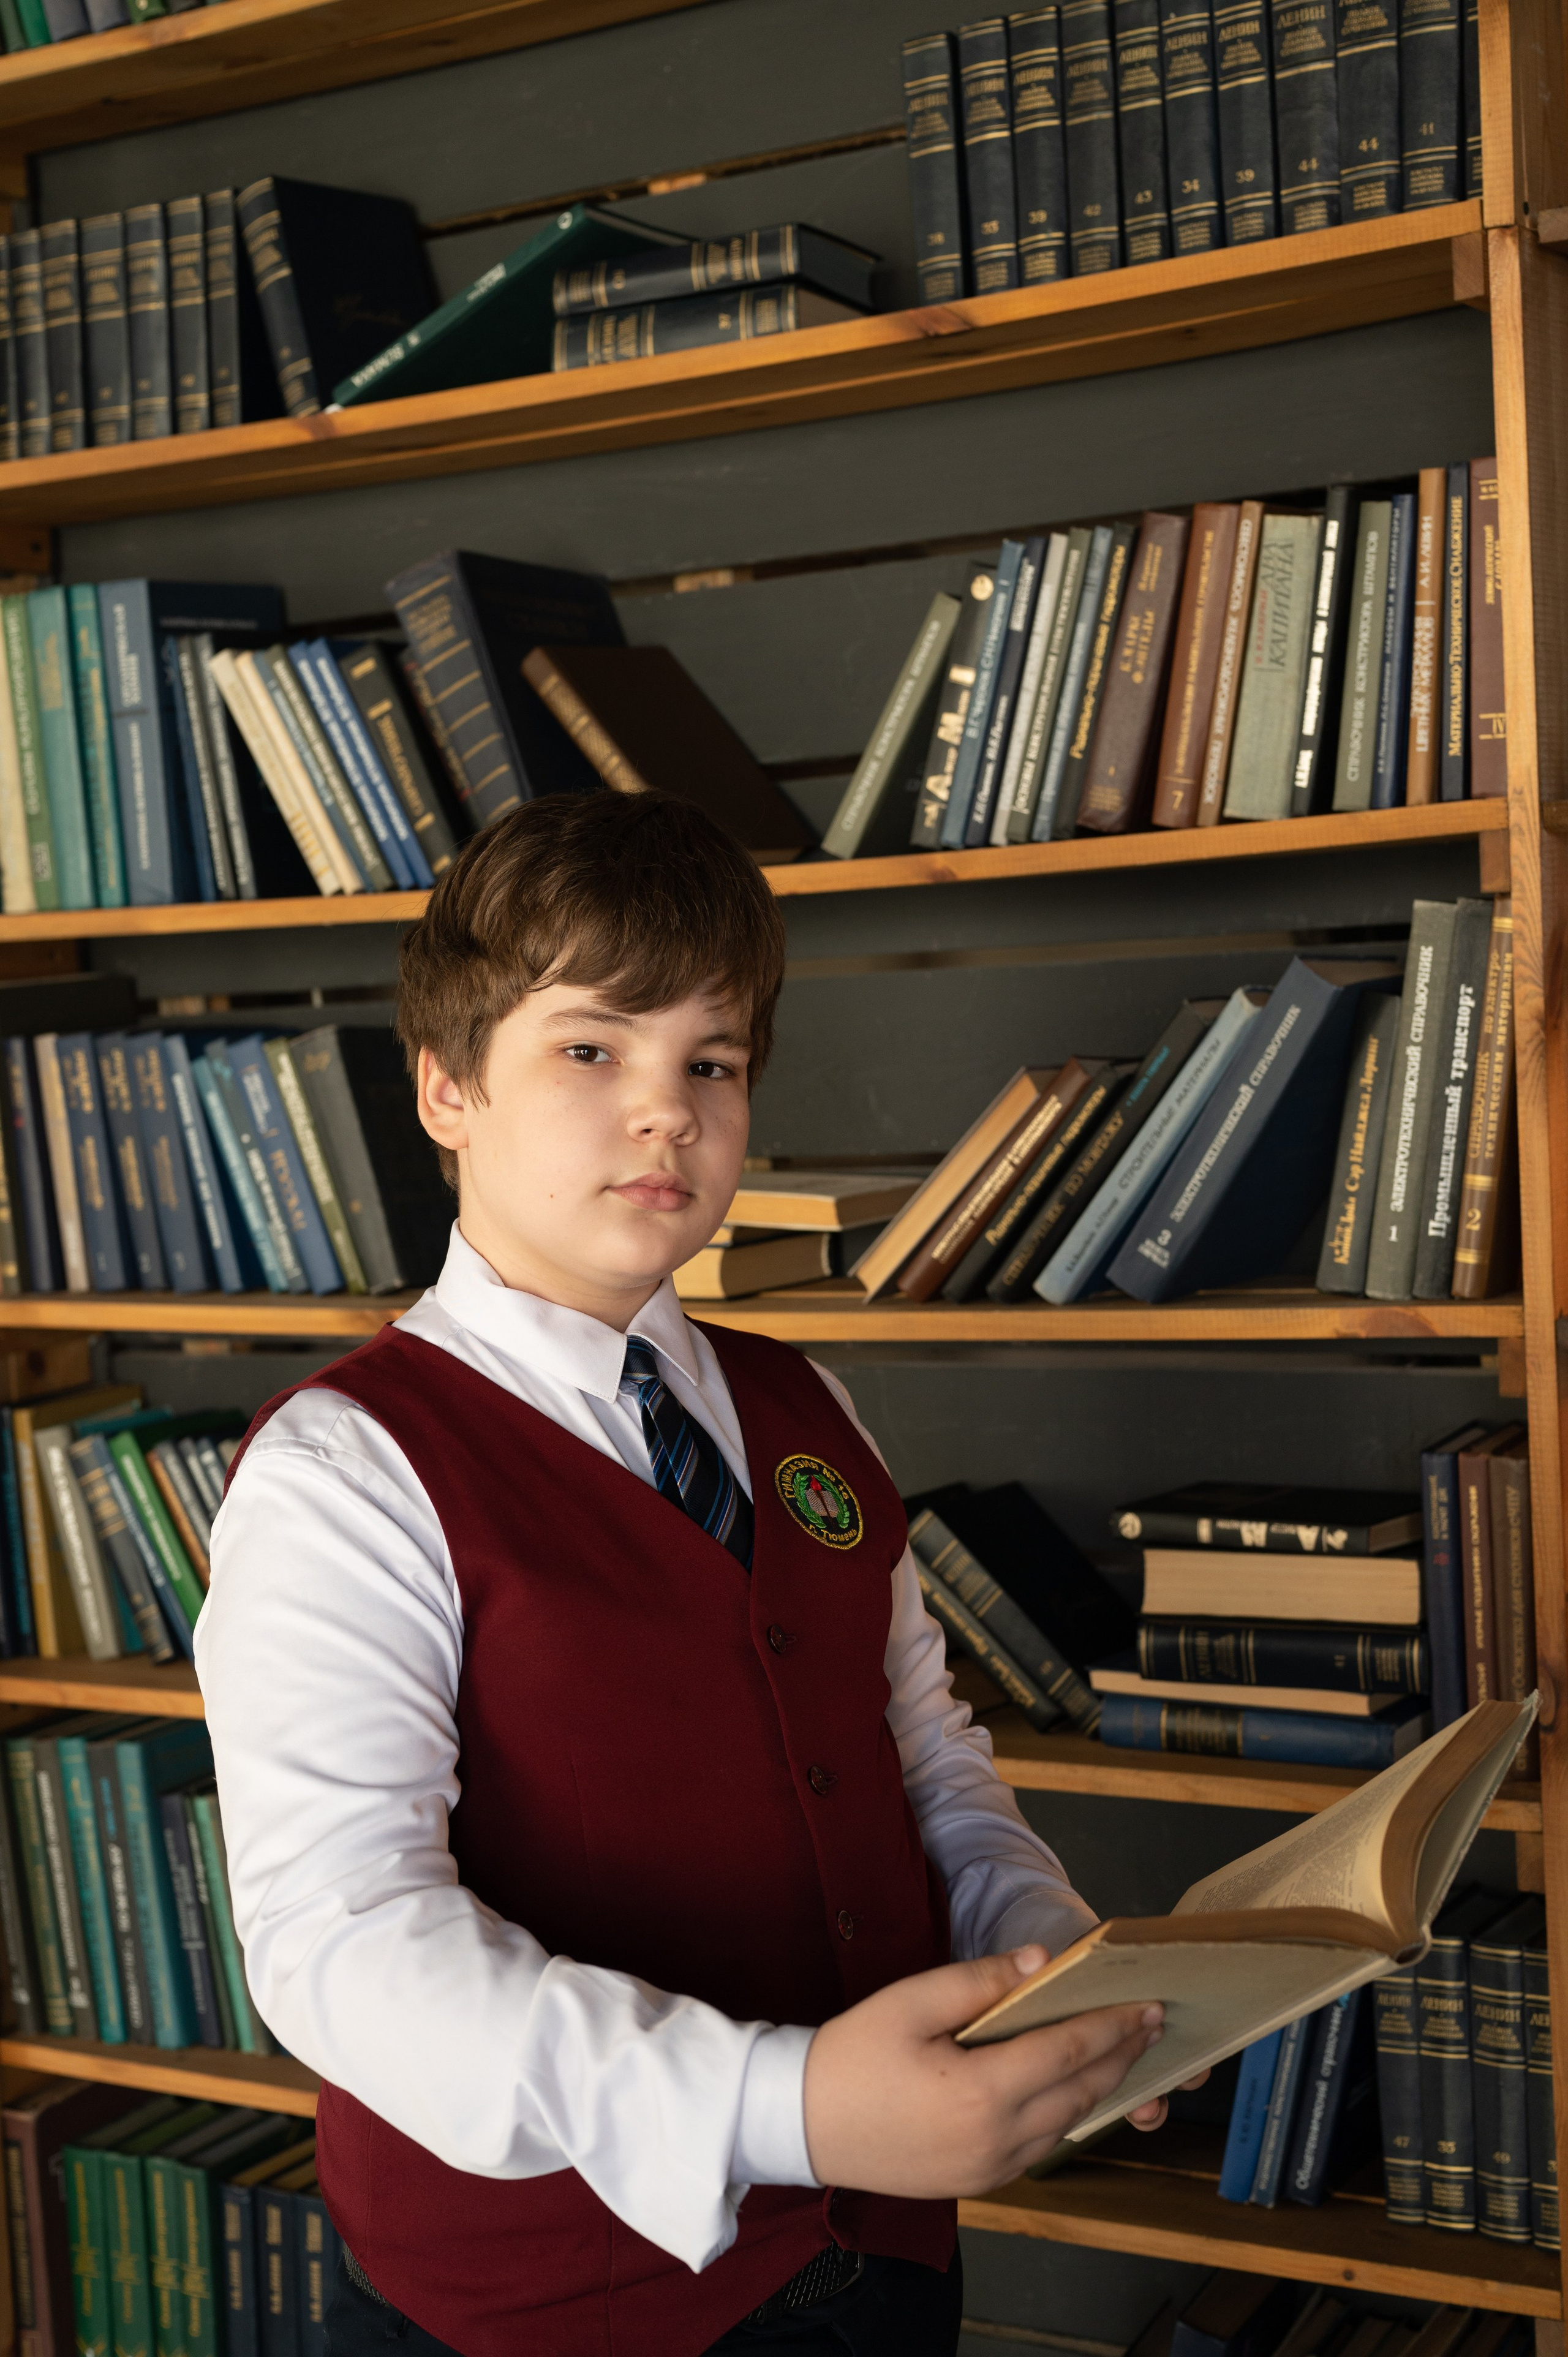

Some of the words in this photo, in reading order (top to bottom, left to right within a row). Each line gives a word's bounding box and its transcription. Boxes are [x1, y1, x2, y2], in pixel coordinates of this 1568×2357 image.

[1298, 157, 1319, 173] 44
[1358, 137, 1379, 153] 44
[1362, 530, 1379, 595] ШТАМПОВ
[1354, 599, 1374, 692] КОНСТРУКТОРА
[1347, 696, 1365, 782] СПРАВОЧНИК
[1172, 790, 1184, 810] 7
[1115, 1106, 1177, 1192] СТРОИТЕЛЬНЫЕ
[1170, 1036, 1223, 1107] МАТЕРИАЛЫ
[1169, 1082, 1255, 1223] ЭЛЕКТРОТЕХНИЧЕСКИЙ
[1248, 1003, 1302, 1087] СПРАВОЧНИК
[1390, 1044, 1422, 1212] ЭЛЕКТРОТЕХНИЧЕСКИЙ
[1409, 945, 1433, 1042] СПРАВОЧНИК
[1427, 1084, 1462, 1238] Промышленный
[1449, 984, 1476, 1081] транспорт
[1466, 1050, 1491, 1159] СПРАВОЧНИК
[1482, 1016, 1493, 1033] по
[1482, 1051, 1506, 1160] техническим
[1466, 1209, 1482, 1231] 2
[781, 1460, 819, 1498] ГИМНАЗИЯ
[821, 1529, 858, 1542] ТЮМЕНЬ
